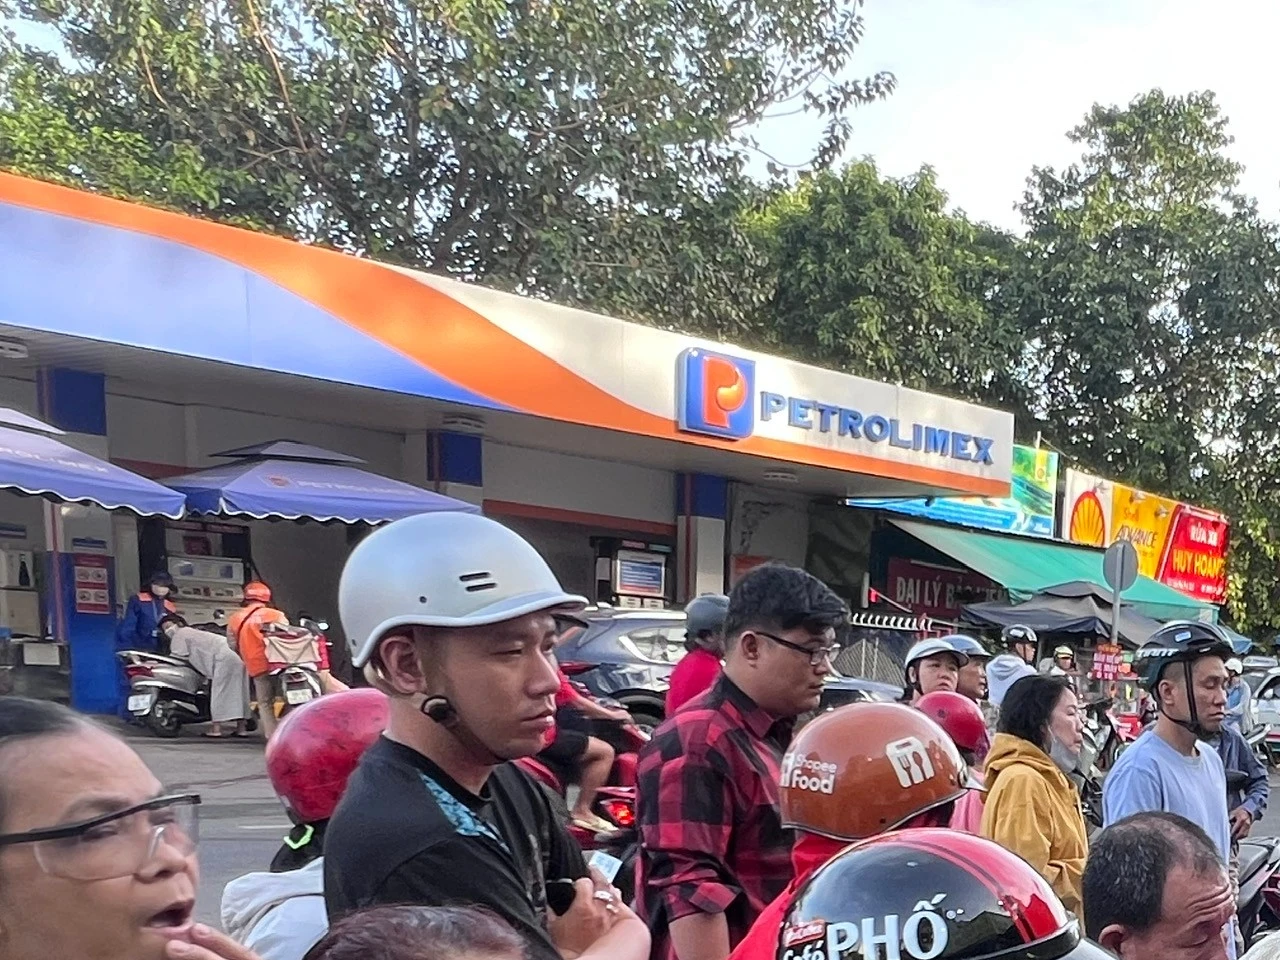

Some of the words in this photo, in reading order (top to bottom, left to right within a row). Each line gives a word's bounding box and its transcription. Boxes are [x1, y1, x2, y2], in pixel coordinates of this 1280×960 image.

[760, 390, 994, 466] PETROLIMEX
[1117, 524, 1159, 549] ADVANCE
[1173, 549, 1194, 573] HUY
[924, 574, 943, 608] LÝ
[796, 753, 838, 774] Shopee
[791, 769, 836, 795] Food
